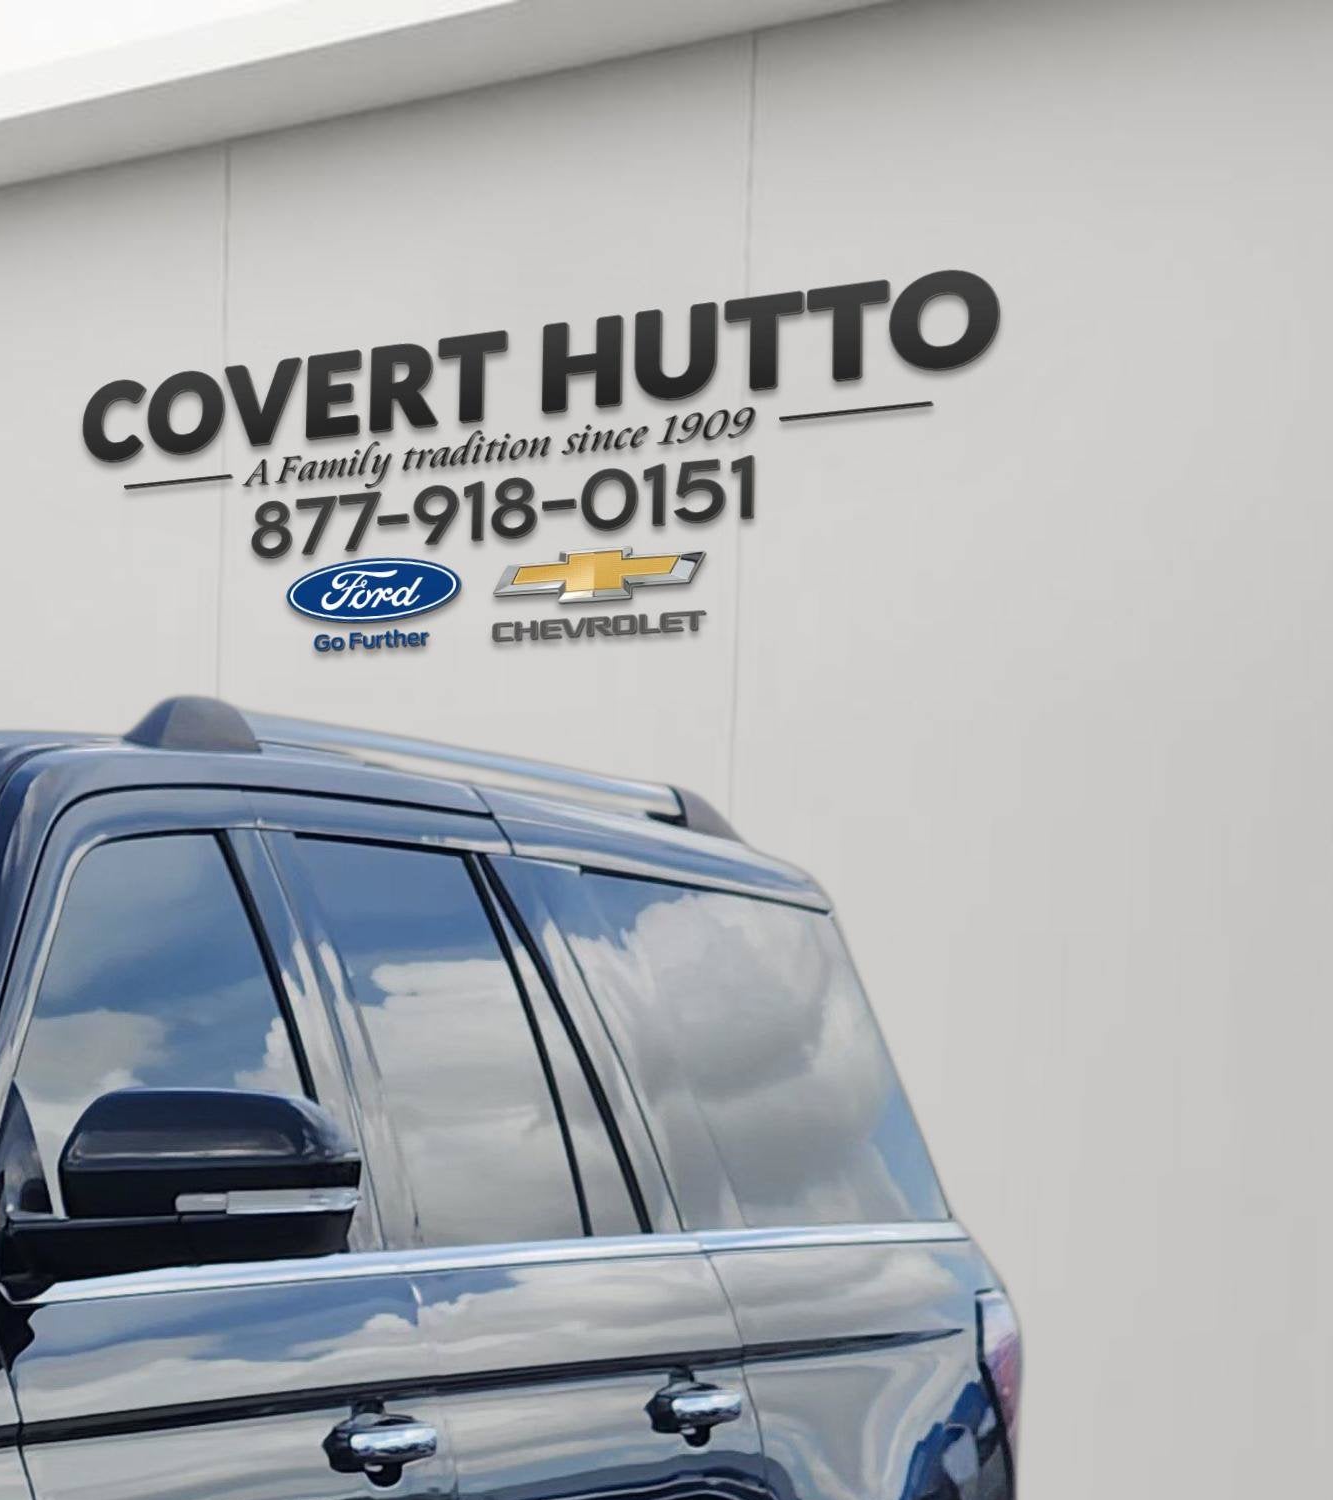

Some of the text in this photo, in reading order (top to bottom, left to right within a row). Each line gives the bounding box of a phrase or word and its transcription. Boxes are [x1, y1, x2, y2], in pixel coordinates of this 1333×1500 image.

[82, 269, 1001, 463] COVERT HUTTO
[242, 406, 757, 489] A Family tradition since 1909
[250, 454, 756, 559] 877-918-0151
[321, 570, 423, 610] Ford
[313, 629, 430, 653] Go Further
[491, 609, 708, 643] CHEVROLET
